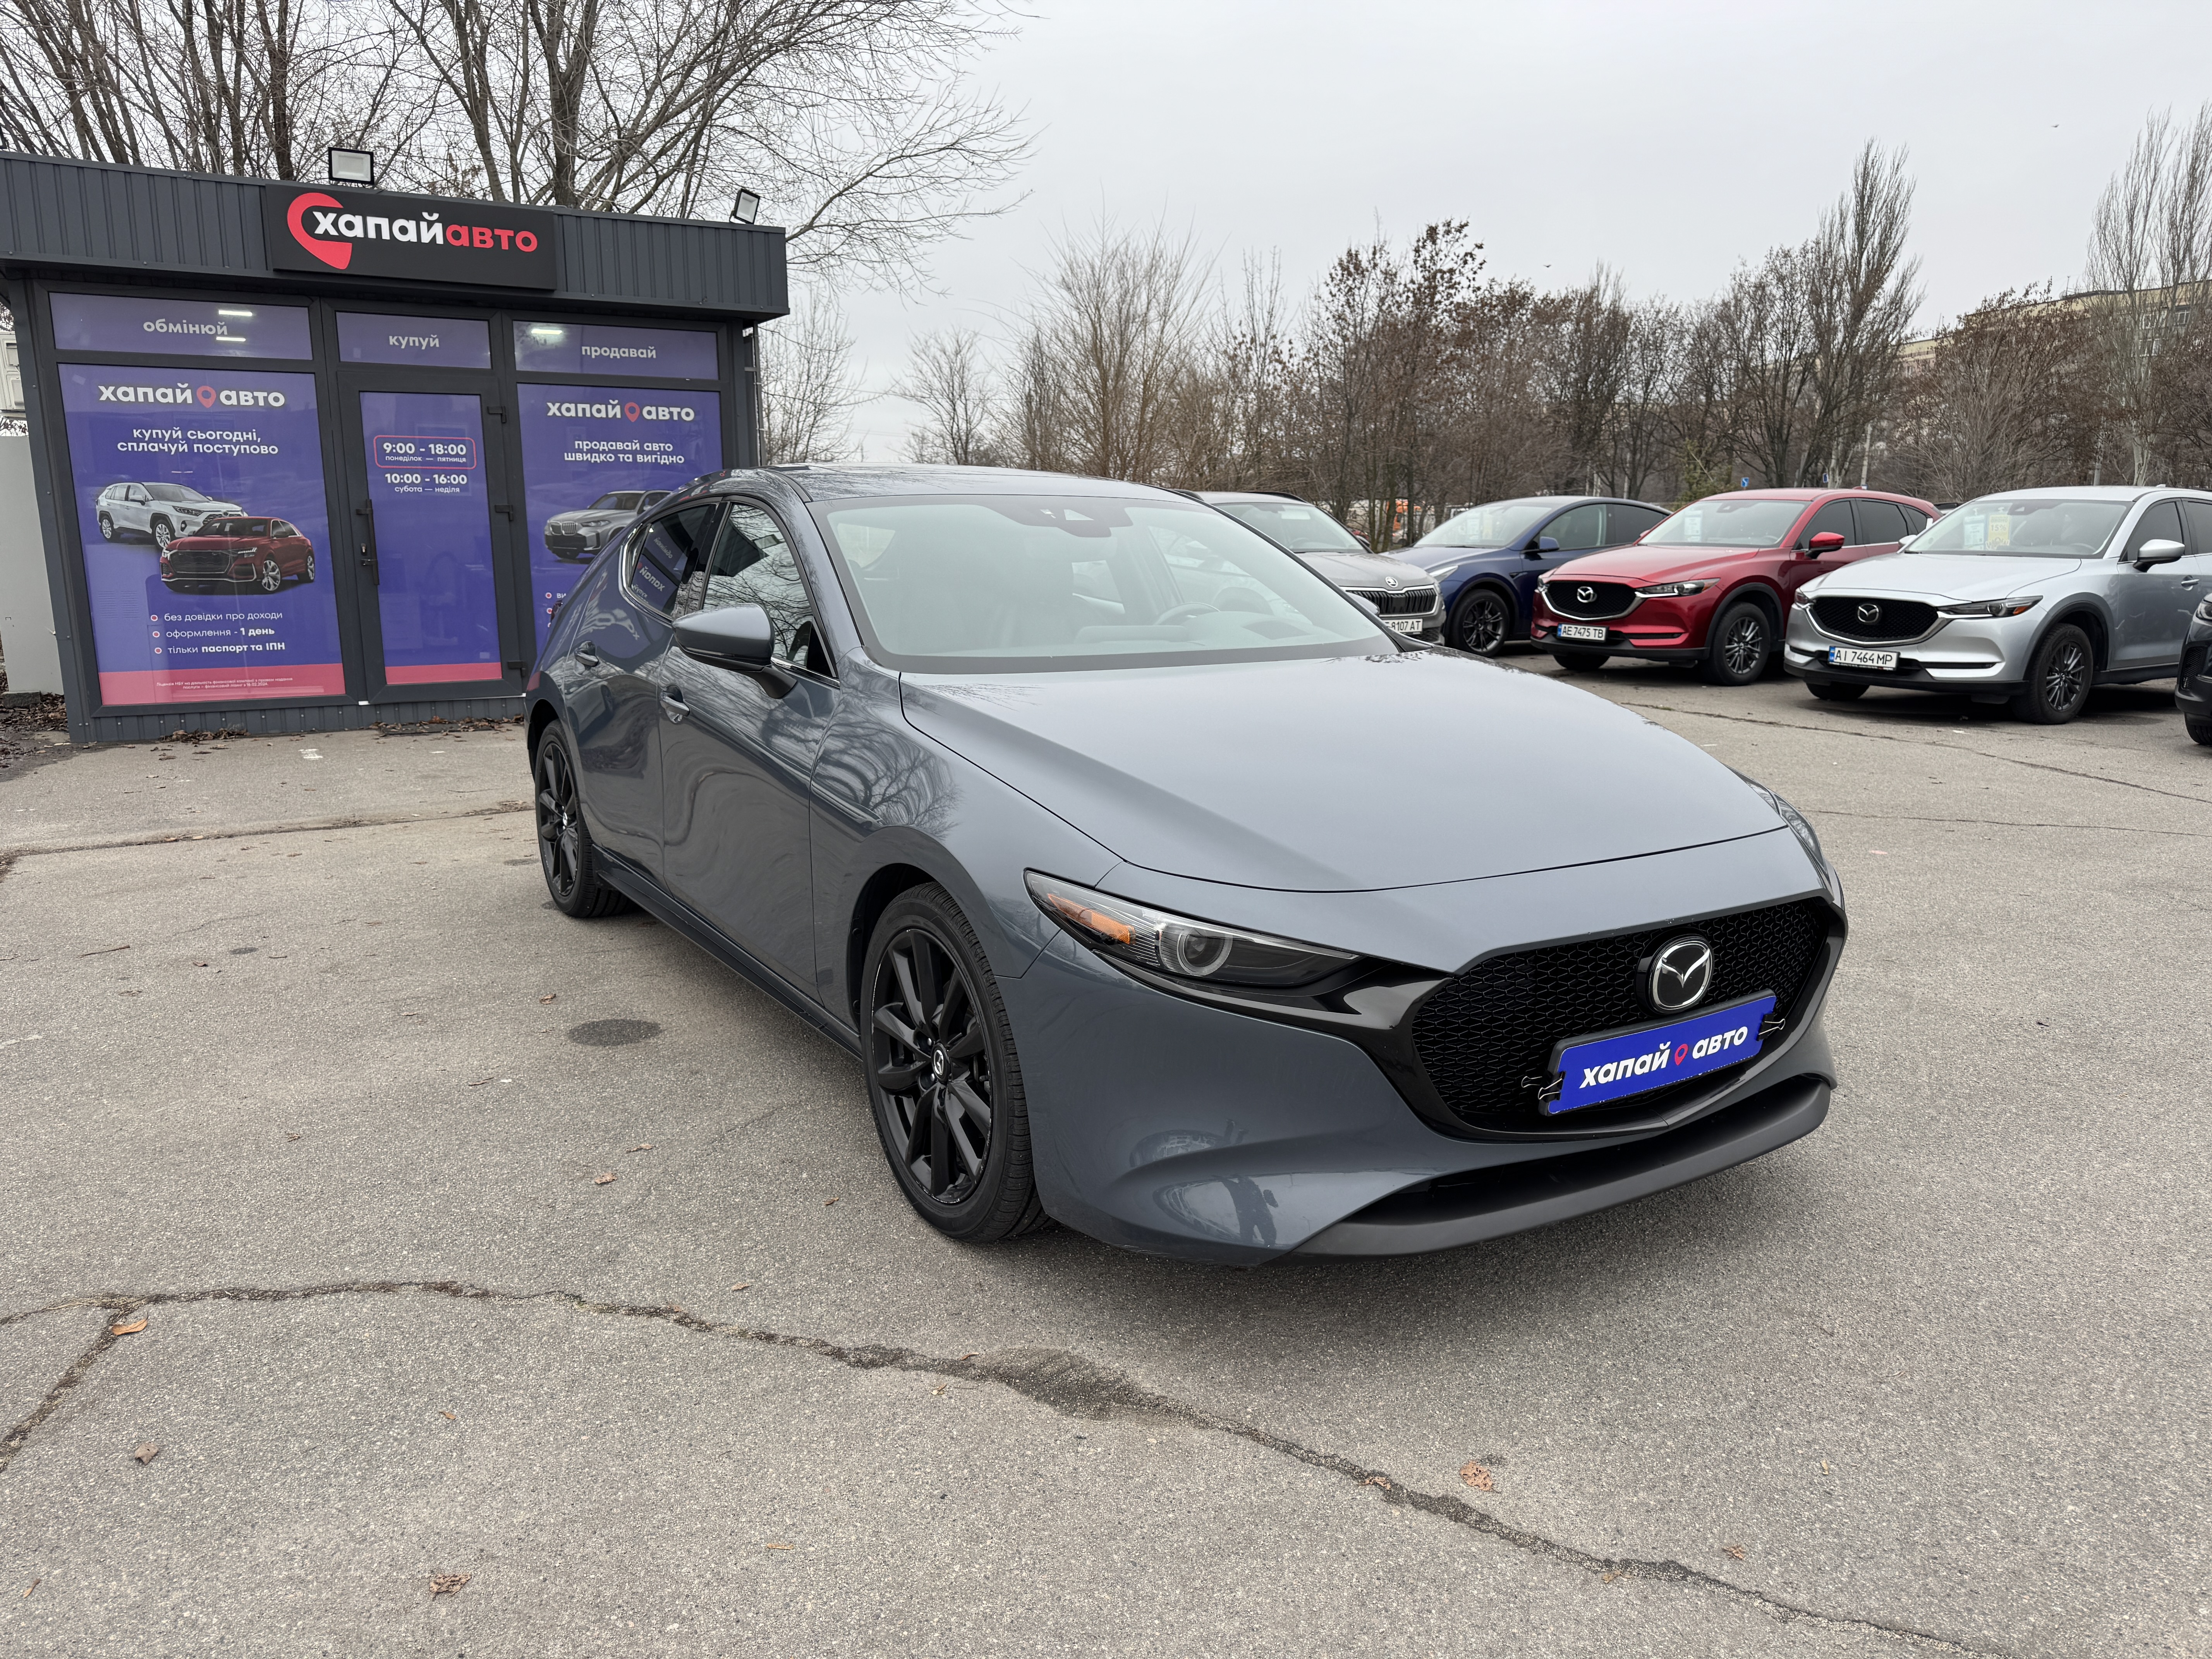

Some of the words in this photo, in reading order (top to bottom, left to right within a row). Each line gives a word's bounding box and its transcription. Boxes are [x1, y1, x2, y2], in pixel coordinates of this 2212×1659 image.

[143, 318, 228, 336] обмінюй
[389, 335, 439, 349] купуй
[582, 347, 656, 358] продавай
[98, 383, 192, 403] хапай
[220, 390, 285, 406] авто
[547, 400, 621, 418] хапай
[642, 406, 694, 421] авто
[133, 427, 182, 441] купуй
[187, 429, 260, 442] сьогодні,
[118, 440, 187, 455] сплачуй
[194, 443, 278, 456] поступово
[383, 443, 415, 453] 9:00
[429, 444, 466, 455] 18:00
[575, 440, 639, 451] продавай
[644, 443, 673, 452] авто
[565, 451, 615, 463] швидко
[637, 452, 684, 464] вигідно
[385, 474, 421, 483] 10:00
[433, 474, 467, 484] 16:00
[185, 613, 222, 622] довідки
[1410, 621, 1421, 630] AT
[1562, 626, 1572, 635] AE
[1574, 627, 1590, 637] 7475
[1593, 629, 1603, 638] TB
[167, 630, 230, 639] оформлення
[1835, 650, 1847, 661] AI
[1851, 651, 1874, 664] 7464
[1877, 654, 1893, 665] MP
[1578, 1041, 1671, 1089] хапай
[1693, 1027, 1748, 1060] авто
